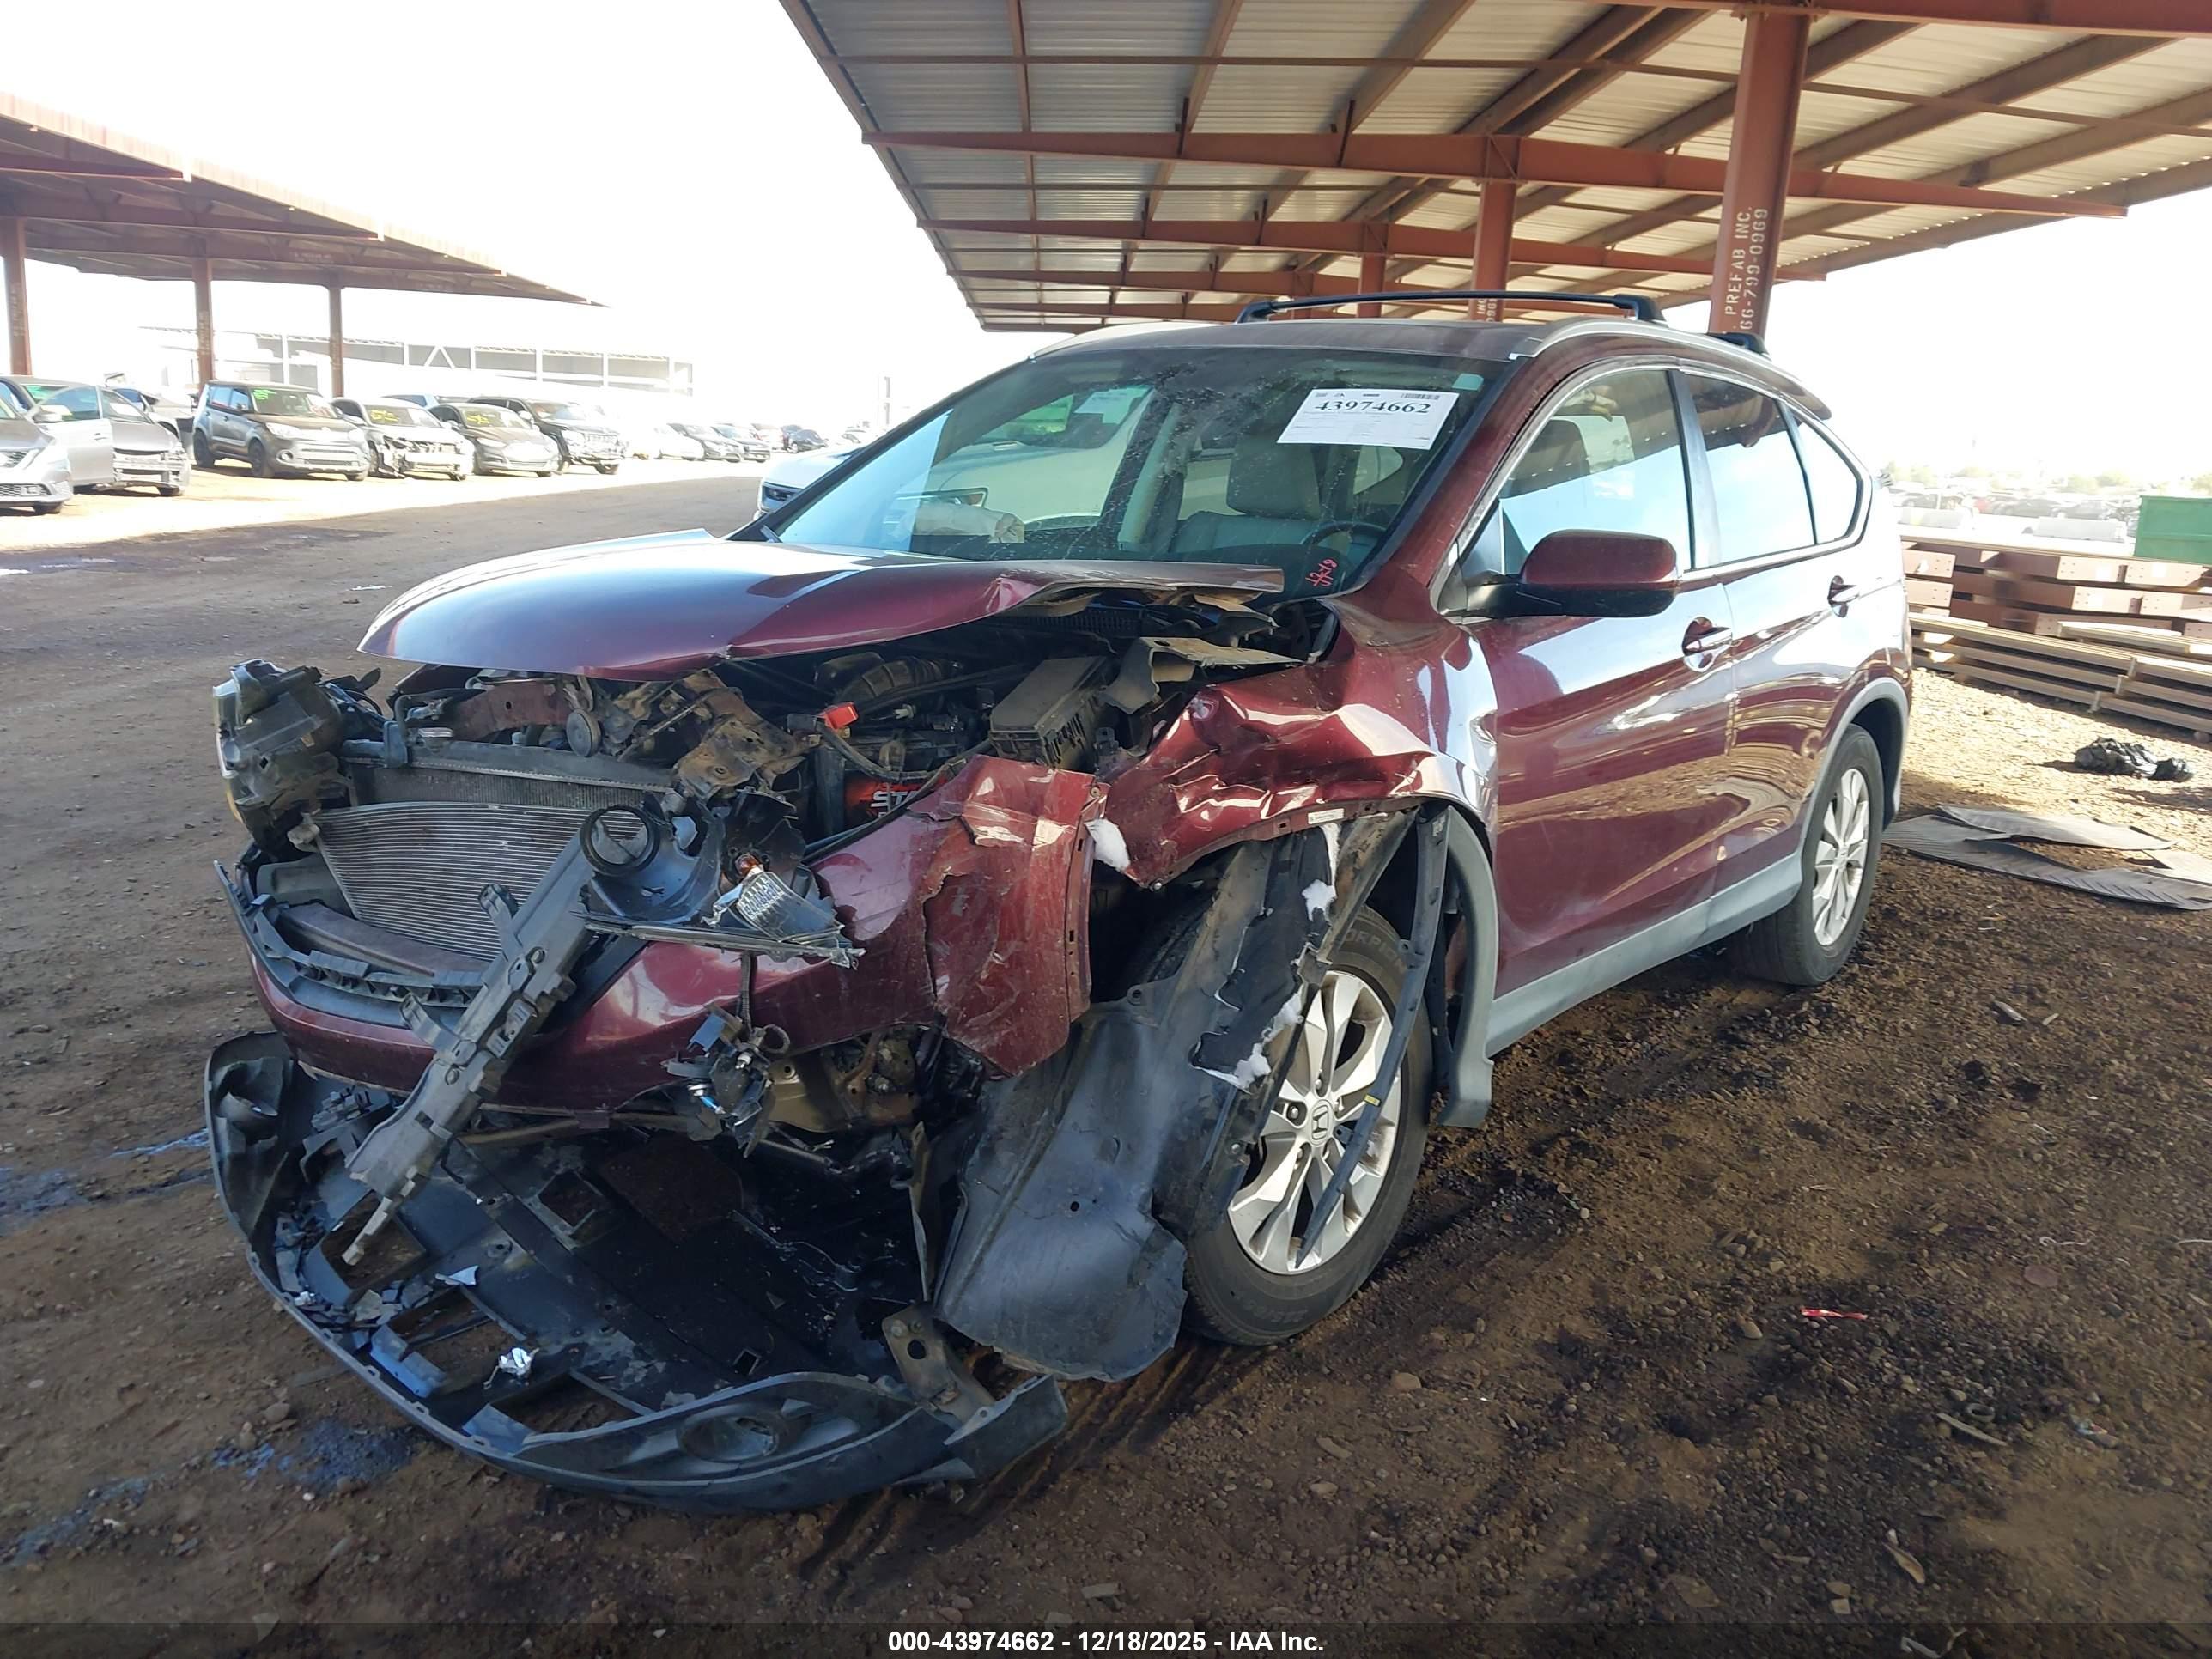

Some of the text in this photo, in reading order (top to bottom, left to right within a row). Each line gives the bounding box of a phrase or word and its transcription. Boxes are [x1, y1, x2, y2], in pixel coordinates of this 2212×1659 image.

[1724, 206, 1753, 315] PREFAB INC.
[1315, 400, 1431, 414] 43974662
